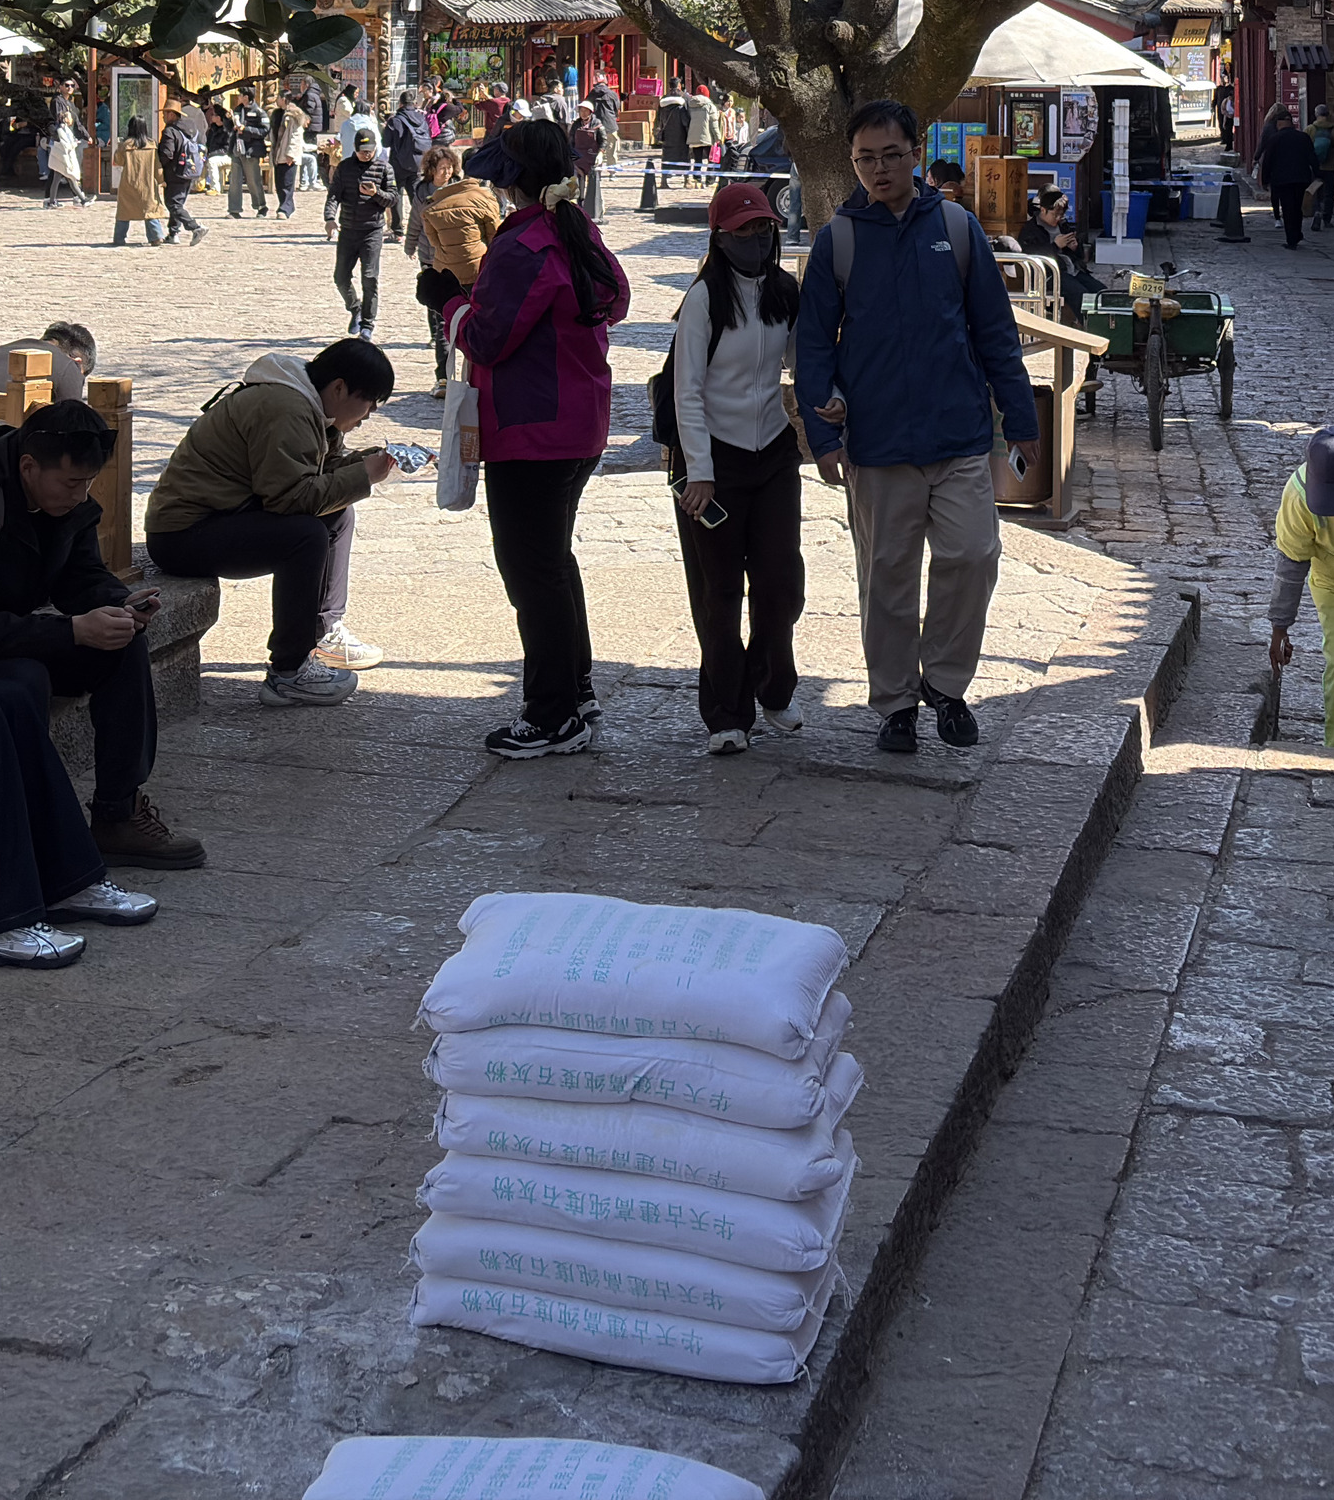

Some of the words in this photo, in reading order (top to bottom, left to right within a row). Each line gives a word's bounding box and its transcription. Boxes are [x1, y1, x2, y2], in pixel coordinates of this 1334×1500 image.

[484, 1060, 732, 1112] 华天古建高纯度石灰粉
[486, 1130, 729, 1190] 华天古建高纯度石灰粉
[491, 1175, 735, 1240] 华天古建高纯度石灰粉
[478, 1249, 724, 1311] 华天古建高纯度石灰粉
[461, 1288, 704, 1355] 华天古建高纯度石灰粉
